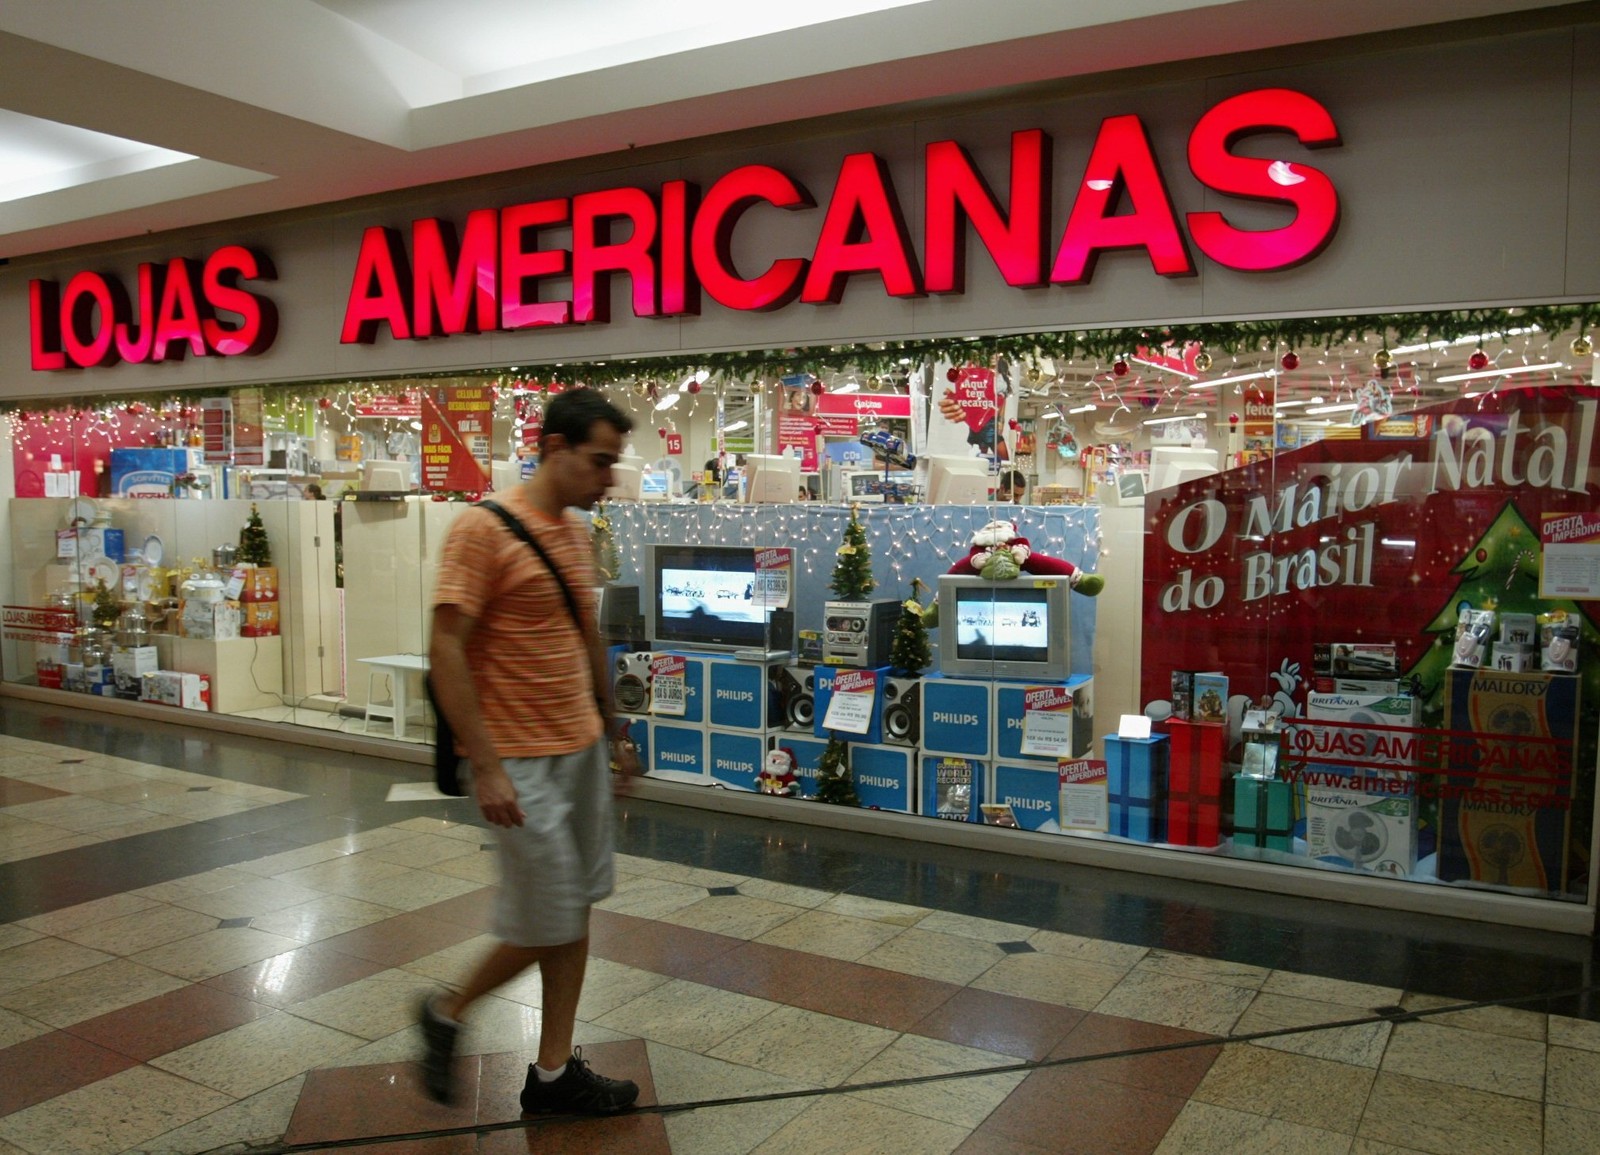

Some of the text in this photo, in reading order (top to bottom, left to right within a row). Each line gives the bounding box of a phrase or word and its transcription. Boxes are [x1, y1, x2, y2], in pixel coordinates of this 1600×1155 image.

[29, 87, 1341, 372] LOJAS AMERICANAS
[965, 389, 986, 399] tem
[957, 398, 994, 409] recarga
[668, 439, 680, 451] 15
[843, 450, 861, 461] CDs
[1167, 399, 1599, 554] O Maior Natal
[1543, 515, 1584, 535] OFERTA
[1162, 522, 1375, 613] do Brasil
[2, 611, 26, 623] LOJAS
[835, 672, 861, 686] OFERTA
[716, 689, 754, 702] PHILIPS
[1025, 688, 1055, 704] OFERTA
[1473, 679, 1549, 697] MALLORY
[1031, 694, 1072, 710] IMPERDÍVEL
[932, 711, 979, 726] PHILIPS
[660, 751, 697, 765] PHILIPS
[1279, 728, 1572, 775] LOJAS AMERICANAS
[716, 759, 754, 773] PHILIPS
[937, 769, 972, 778] WORLD
[1060, 761, 1089, 777] OFERTA
[859, 774, 900, 790] PHILIPS
[1066, 766, 1107, 783] IMPERDÍVEL
[1278, 768, 1572, 811] www.americanas.com
[1005, 796, 1052, 812] PHILIPS
[1462, 800, 1537, 817] MALLORY
